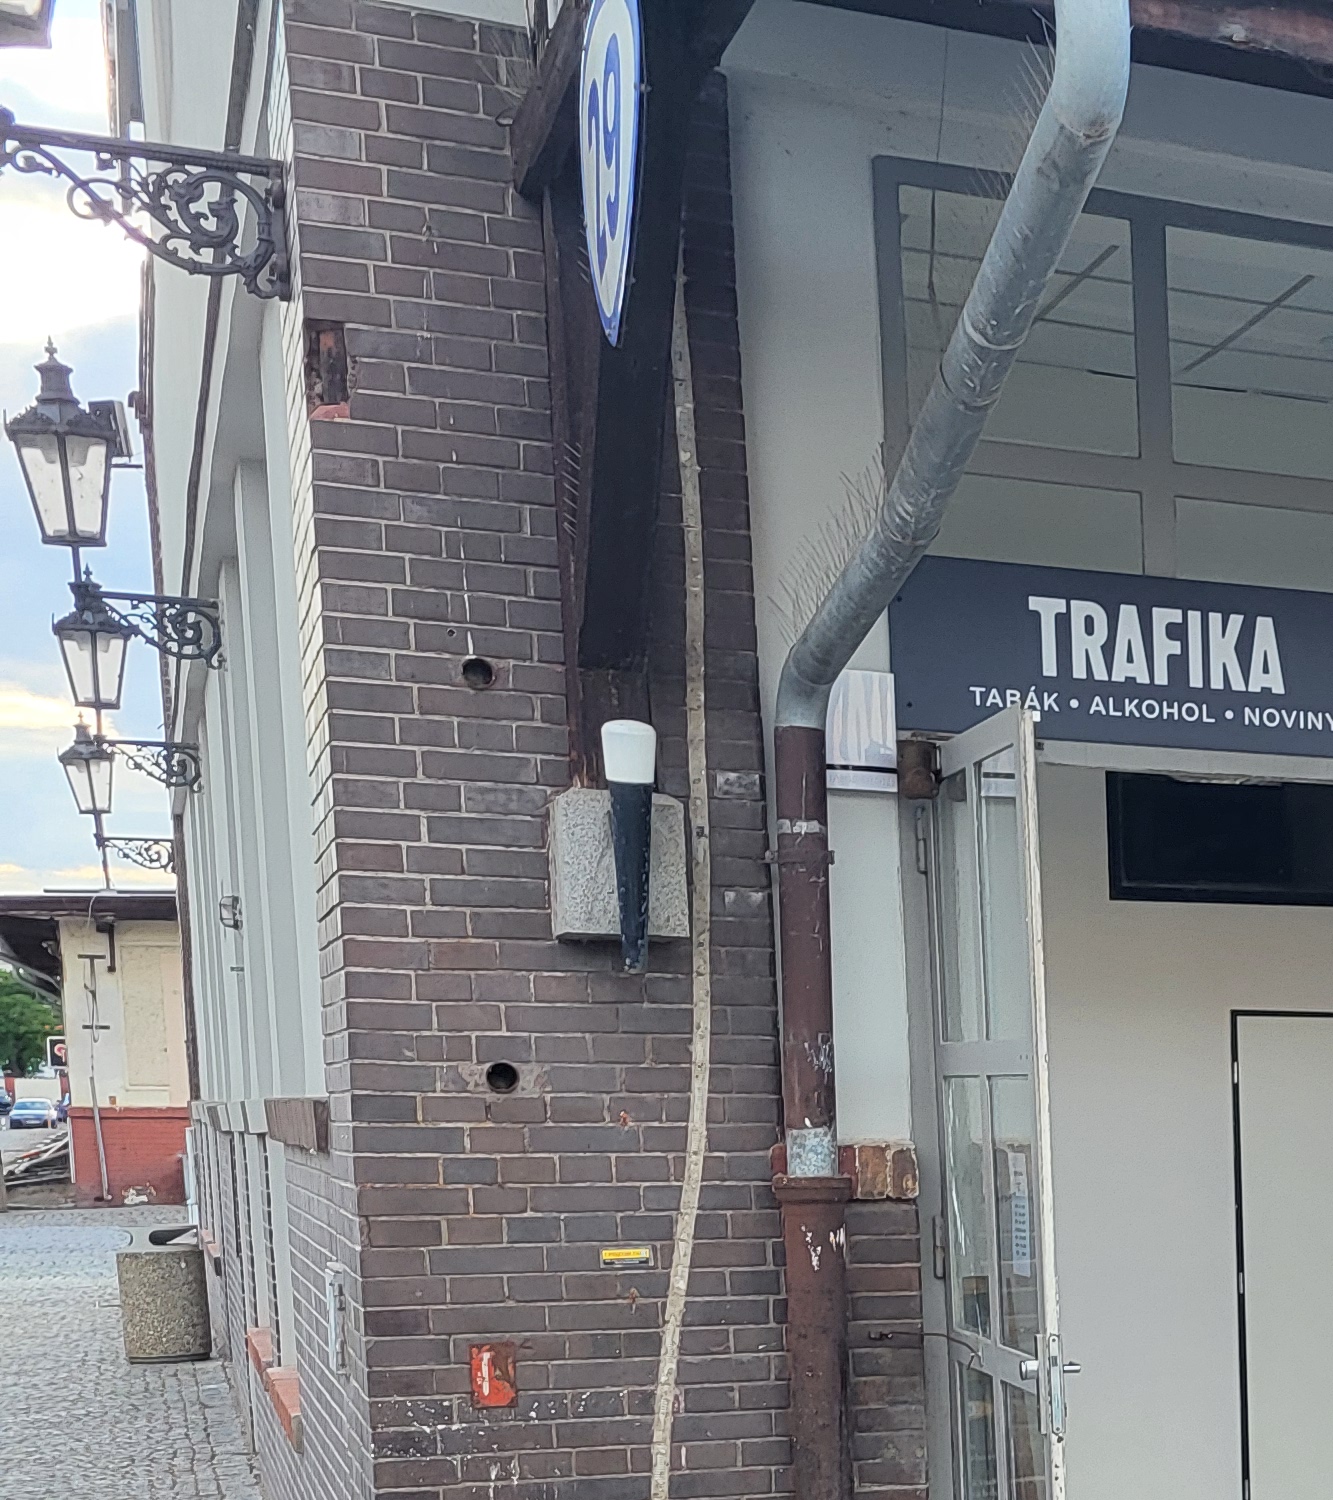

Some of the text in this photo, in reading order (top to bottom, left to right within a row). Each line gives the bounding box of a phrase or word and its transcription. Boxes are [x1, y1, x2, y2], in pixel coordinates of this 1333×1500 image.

[1028, 596, 1285, 695] TRAFIKA
[968, 685, 1061, 713] TABÁK
[1088, 695, 1217, 724] ALKOHOL
